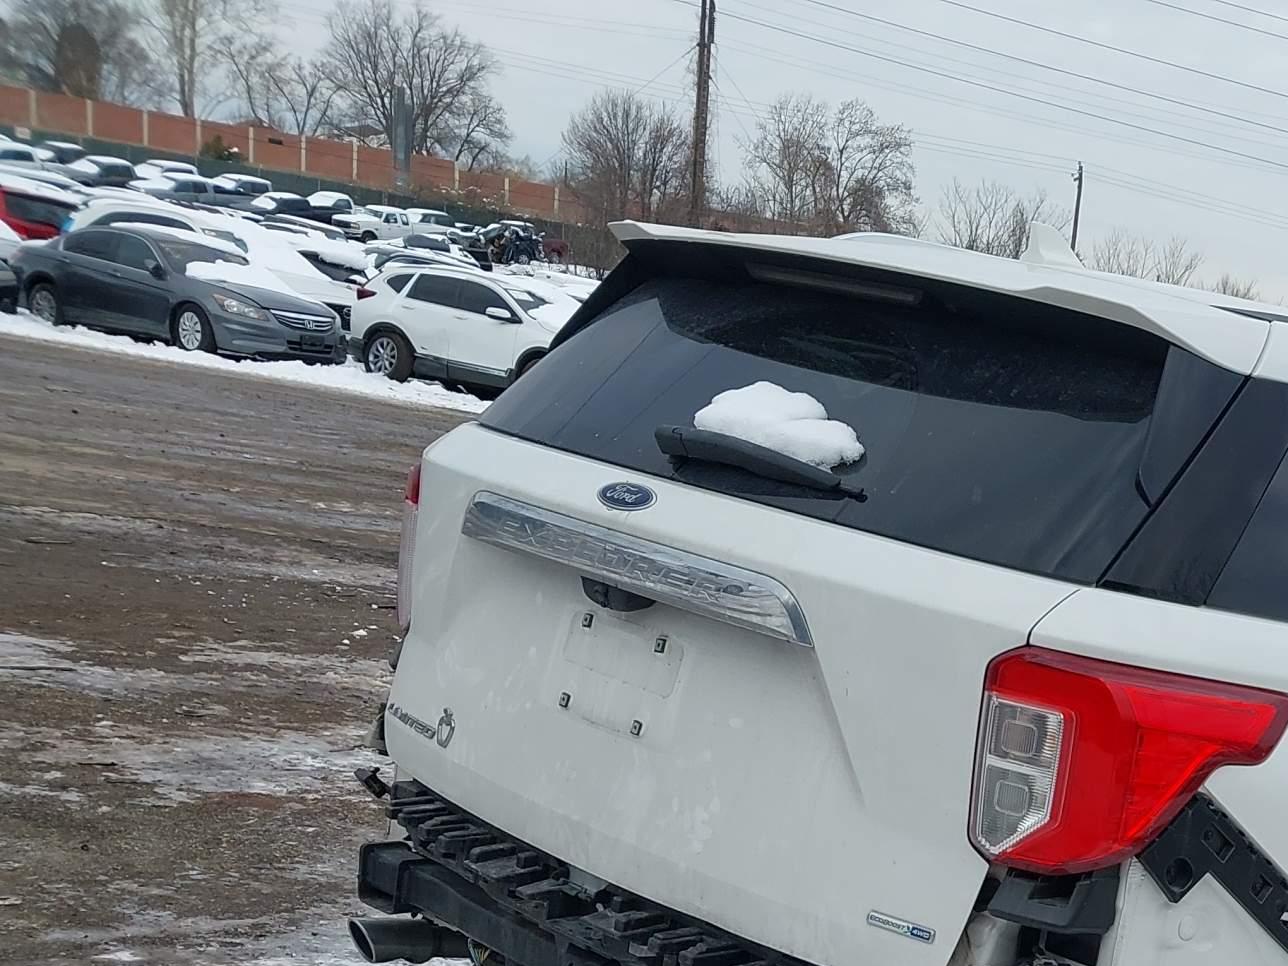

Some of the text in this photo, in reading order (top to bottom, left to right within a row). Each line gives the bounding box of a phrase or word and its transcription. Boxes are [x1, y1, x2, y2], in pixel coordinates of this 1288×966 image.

[604, 484, 644, 503] Ford
[497, 520, 723, 602] EXPLORER
[911, 928, 930, 940] 4WD
